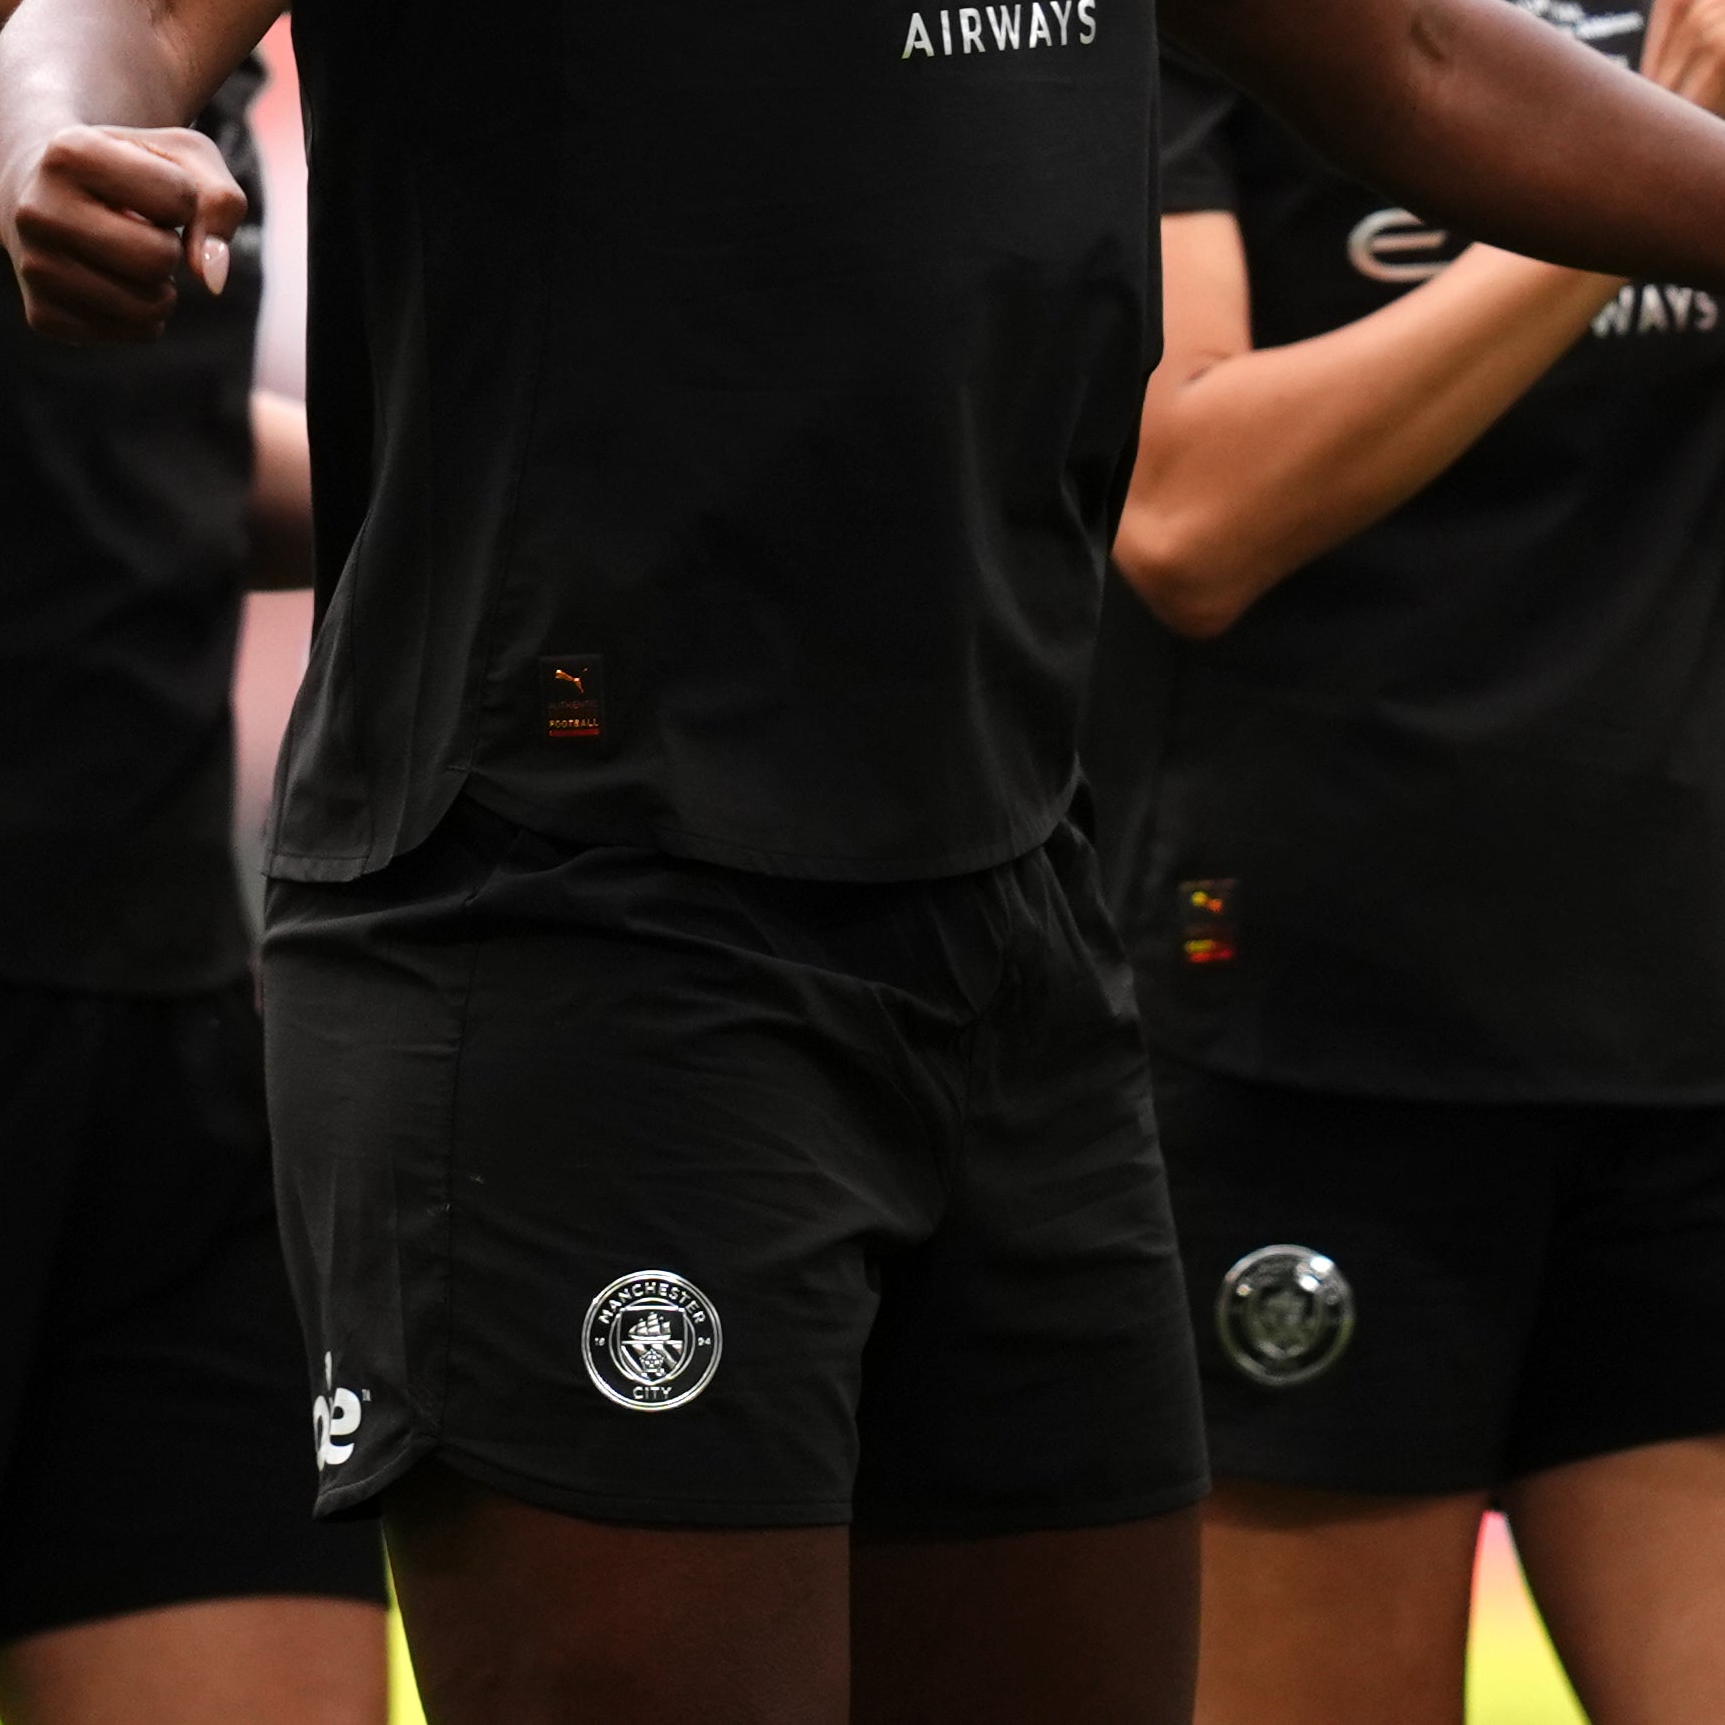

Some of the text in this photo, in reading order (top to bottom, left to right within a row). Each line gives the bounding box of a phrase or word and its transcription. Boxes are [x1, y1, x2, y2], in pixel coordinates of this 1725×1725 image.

[1590, 283, 1718, 338] WAYS
[549, 718, 599, 728] FOOTBALL
[598, 1281, 706, 1325] MANCHESTER
[632, 1386, 673, 1400] CITY
